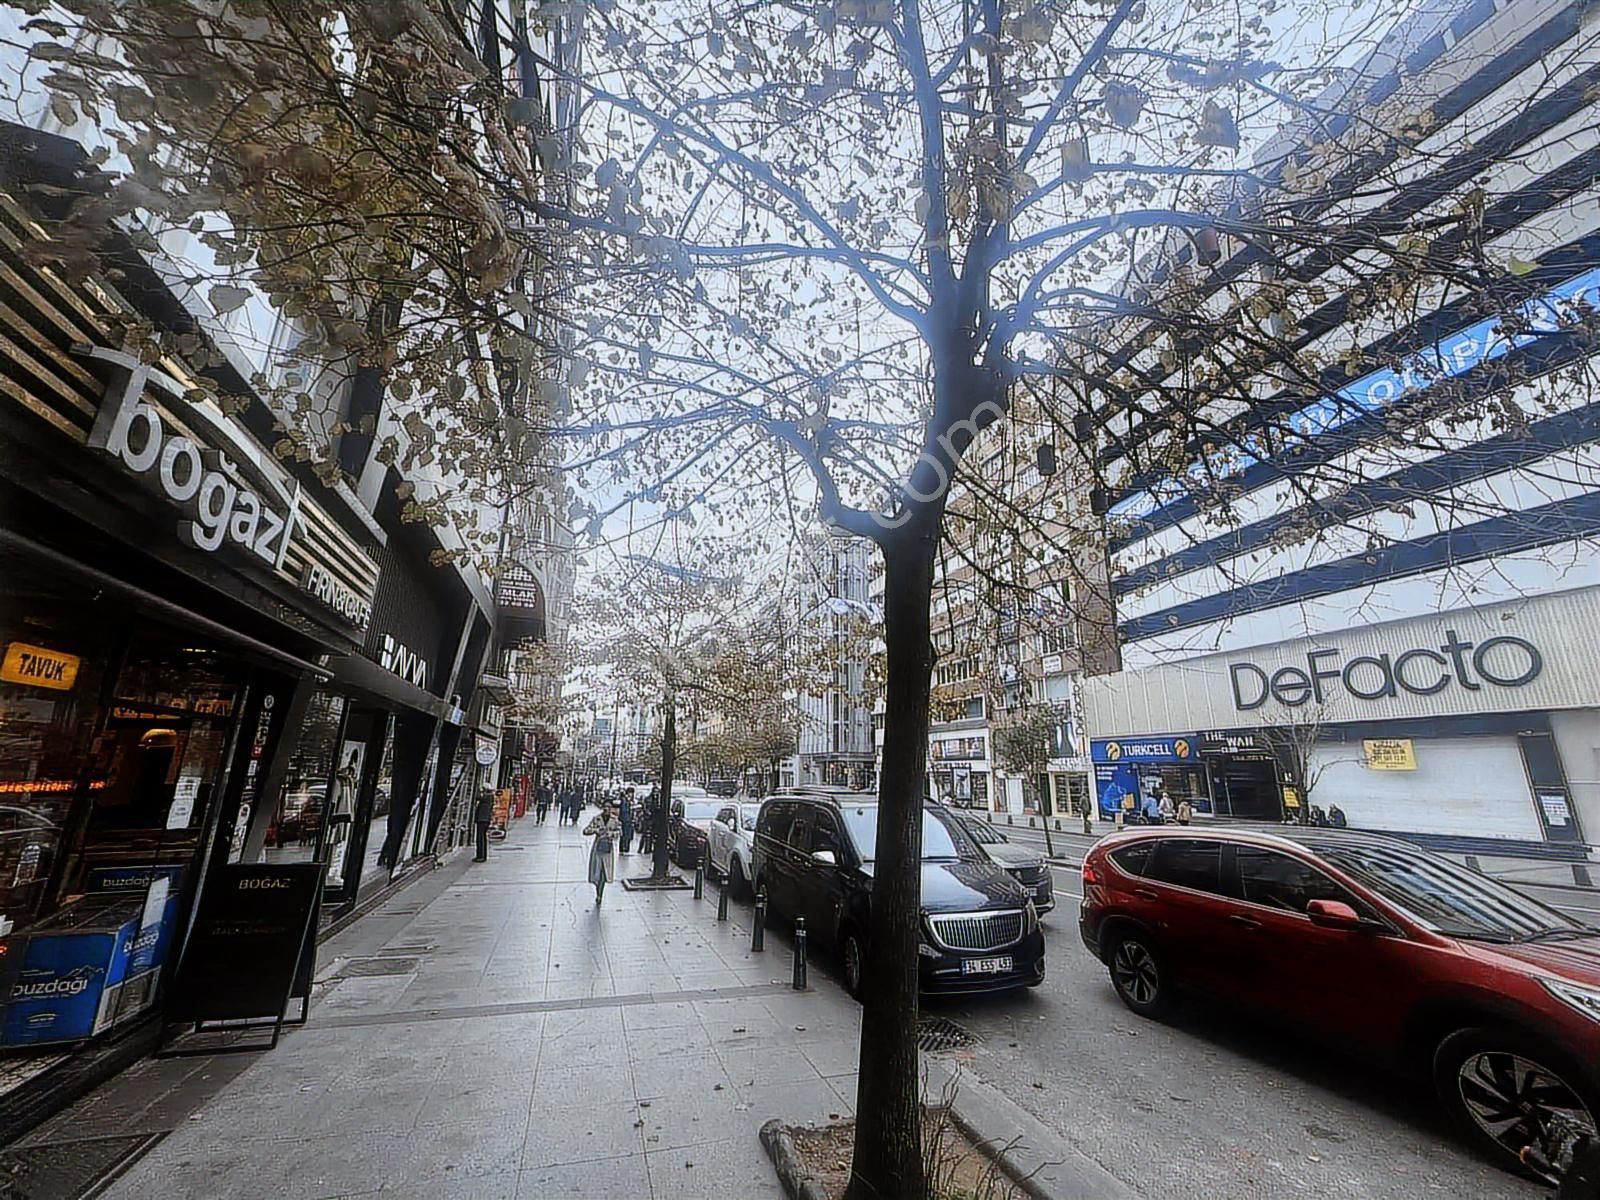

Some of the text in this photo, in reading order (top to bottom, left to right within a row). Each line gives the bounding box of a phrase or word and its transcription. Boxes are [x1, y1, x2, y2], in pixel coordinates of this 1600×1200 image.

[106, 363, 285, 566] boğaz
[18, 652, 68, 682] TAVUK
[1229, 630, 1543, 711] DeFacto
[1122, 743, 1172, 757] TURKCELL
[1205, 730, 1226, 742] THE
